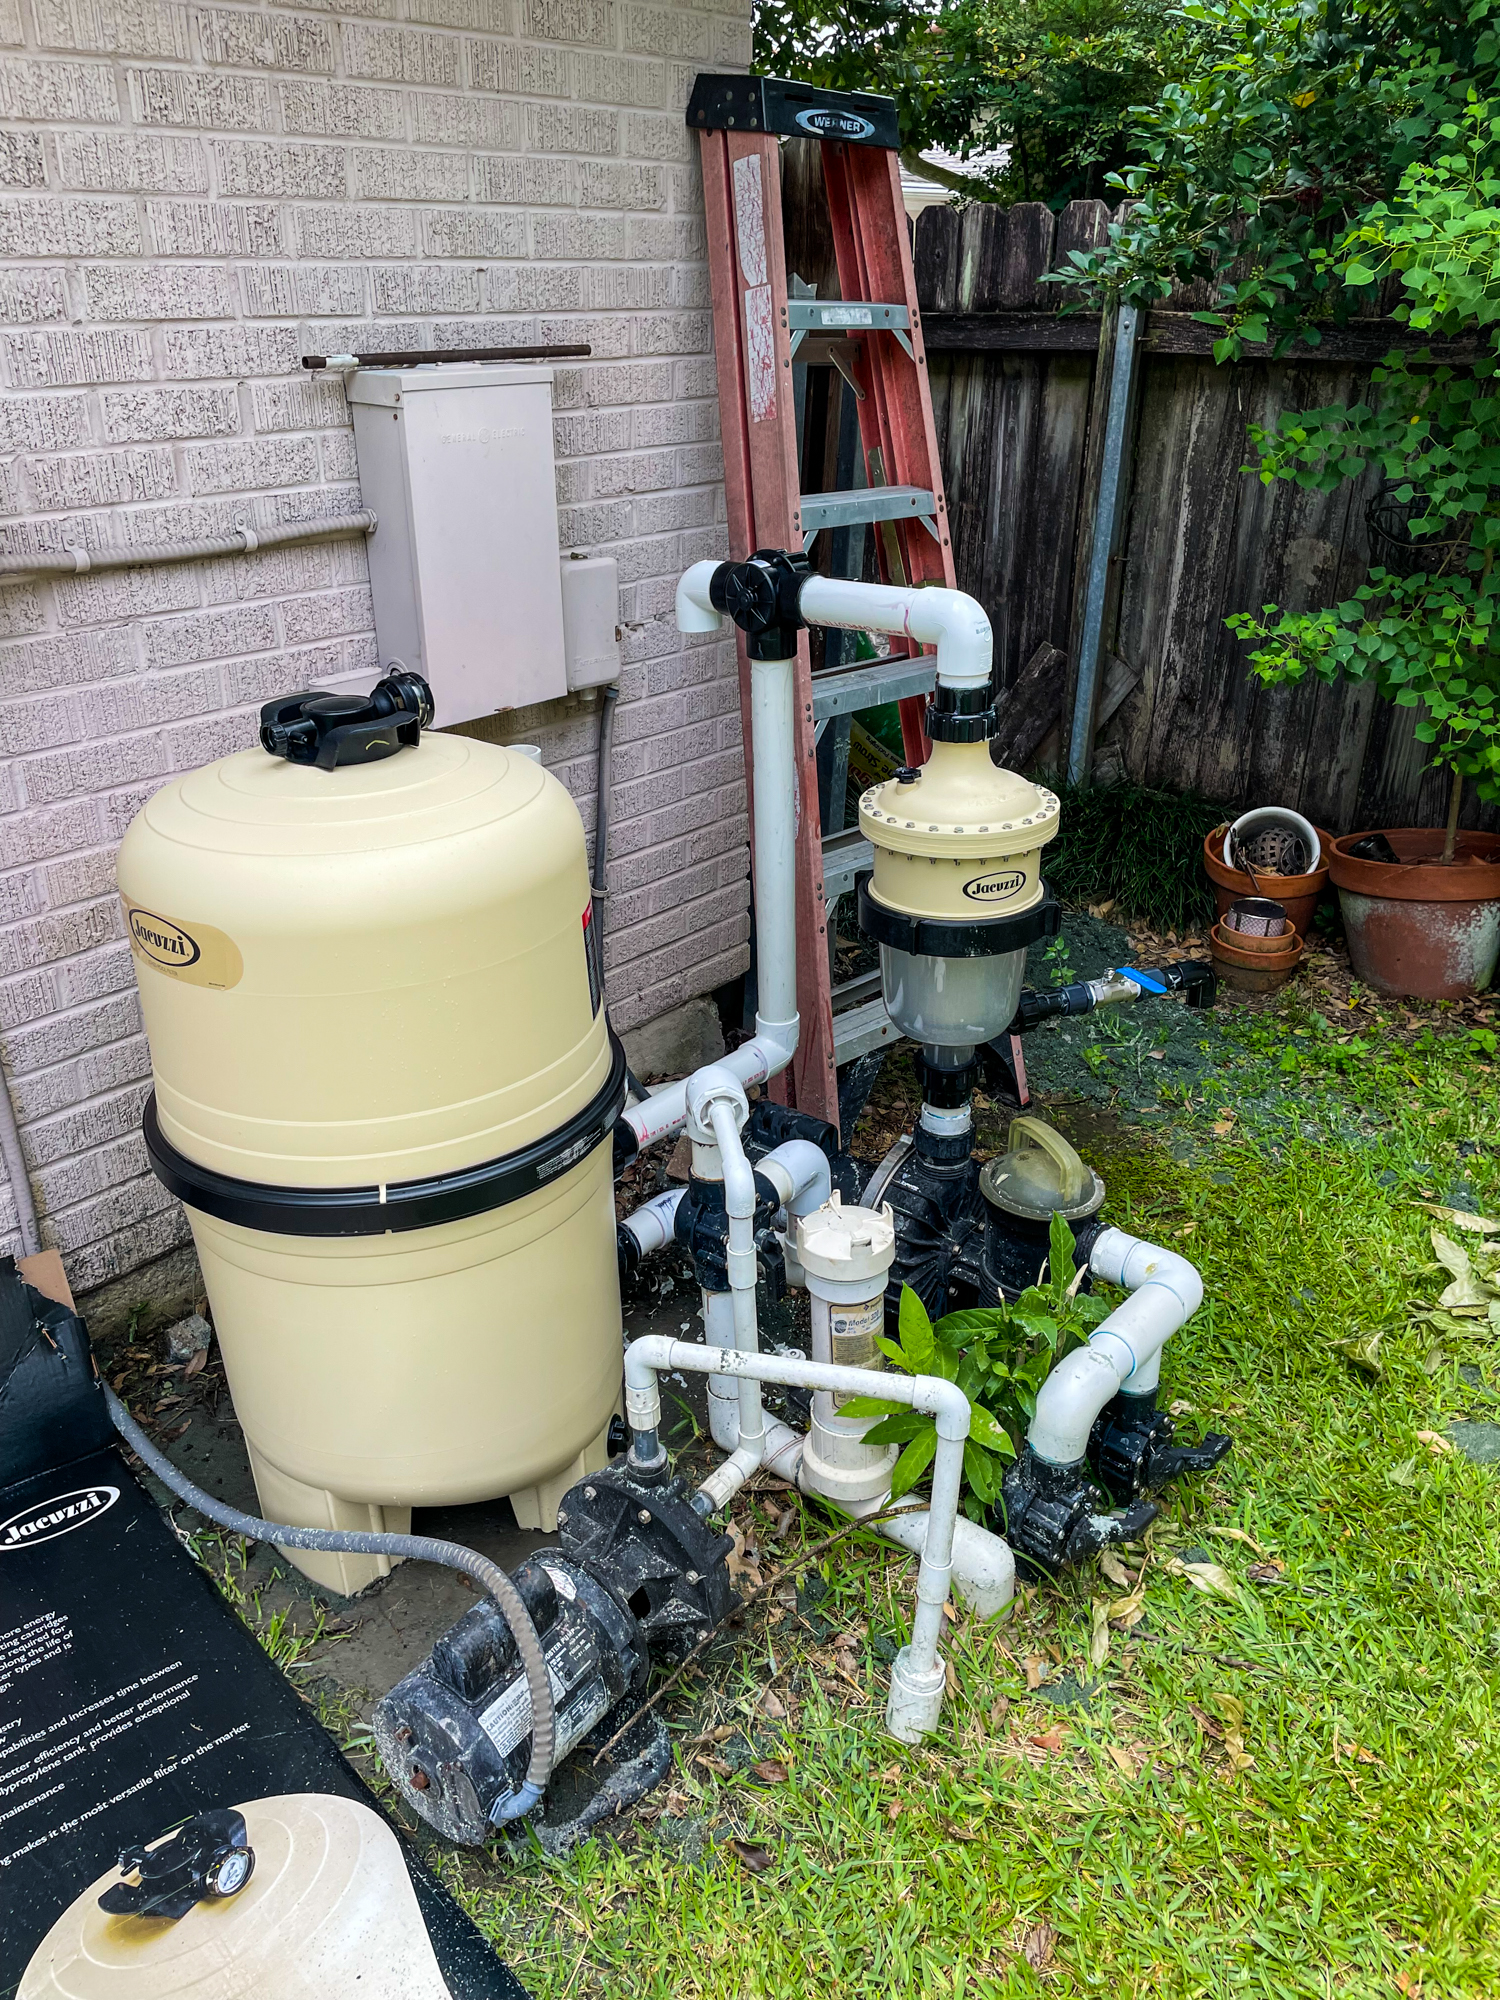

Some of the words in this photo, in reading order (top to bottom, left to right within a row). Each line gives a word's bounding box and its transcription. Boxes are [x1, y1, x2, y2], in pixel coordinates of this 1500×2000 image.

[853, 741, 881, 768] Straw
[972, 875, 1020, 895] Jacuzzi
[135, 918, 187, 957] Jacuzzi
[4, 1492, 102, 1544] Jacuzzi
[20, 1615, 69, 1640] cartridges
[23, 1611, 56, 1629] energy
[8, 1632, 50, 1657] required
[51, 1625, 66, 1636] for
[14, 1657, 42, 1673] types
[43, 1645, 62, 1660] and
[62, 1642, 72, 1650] is
[27, 1646, 45, 1657] the
[45, 1638, 61, 1648] life
[63, 1629, 74, 1640] of
[47, 1716, 68, 1733] and
[68, 1694, 115, 1722] increases
[116, 1682, 139, 1697] time
[139, 1660, 183, 1685] between
[33, 1734, 81, 1764] efficiency
[82, 1722, 103, 1738] and
[102, 1706, 135, 1727] better
[136, 1674, 199, 1710] performance
[63, 1745, 87, 1762] tank
[89, 1720, 133, 1749] provides
[134, 1689, 191, 1723] exceptional
[0, 1782, 66, 1821] maintenance
[12, 1836, 48, 1859] makes
[48, 1829, 60, 1839] it
[60, 1818, 79, 1832] the
[80, 1801, 109, 1821] most
[109, 1776, 154, 1804] versatile
[153, 1761, 179, 1780] filter
[180, 1753, 196, 1765] on
[196, 1741, 214, 1756] the
[213, 1721, 252, 1746] market
